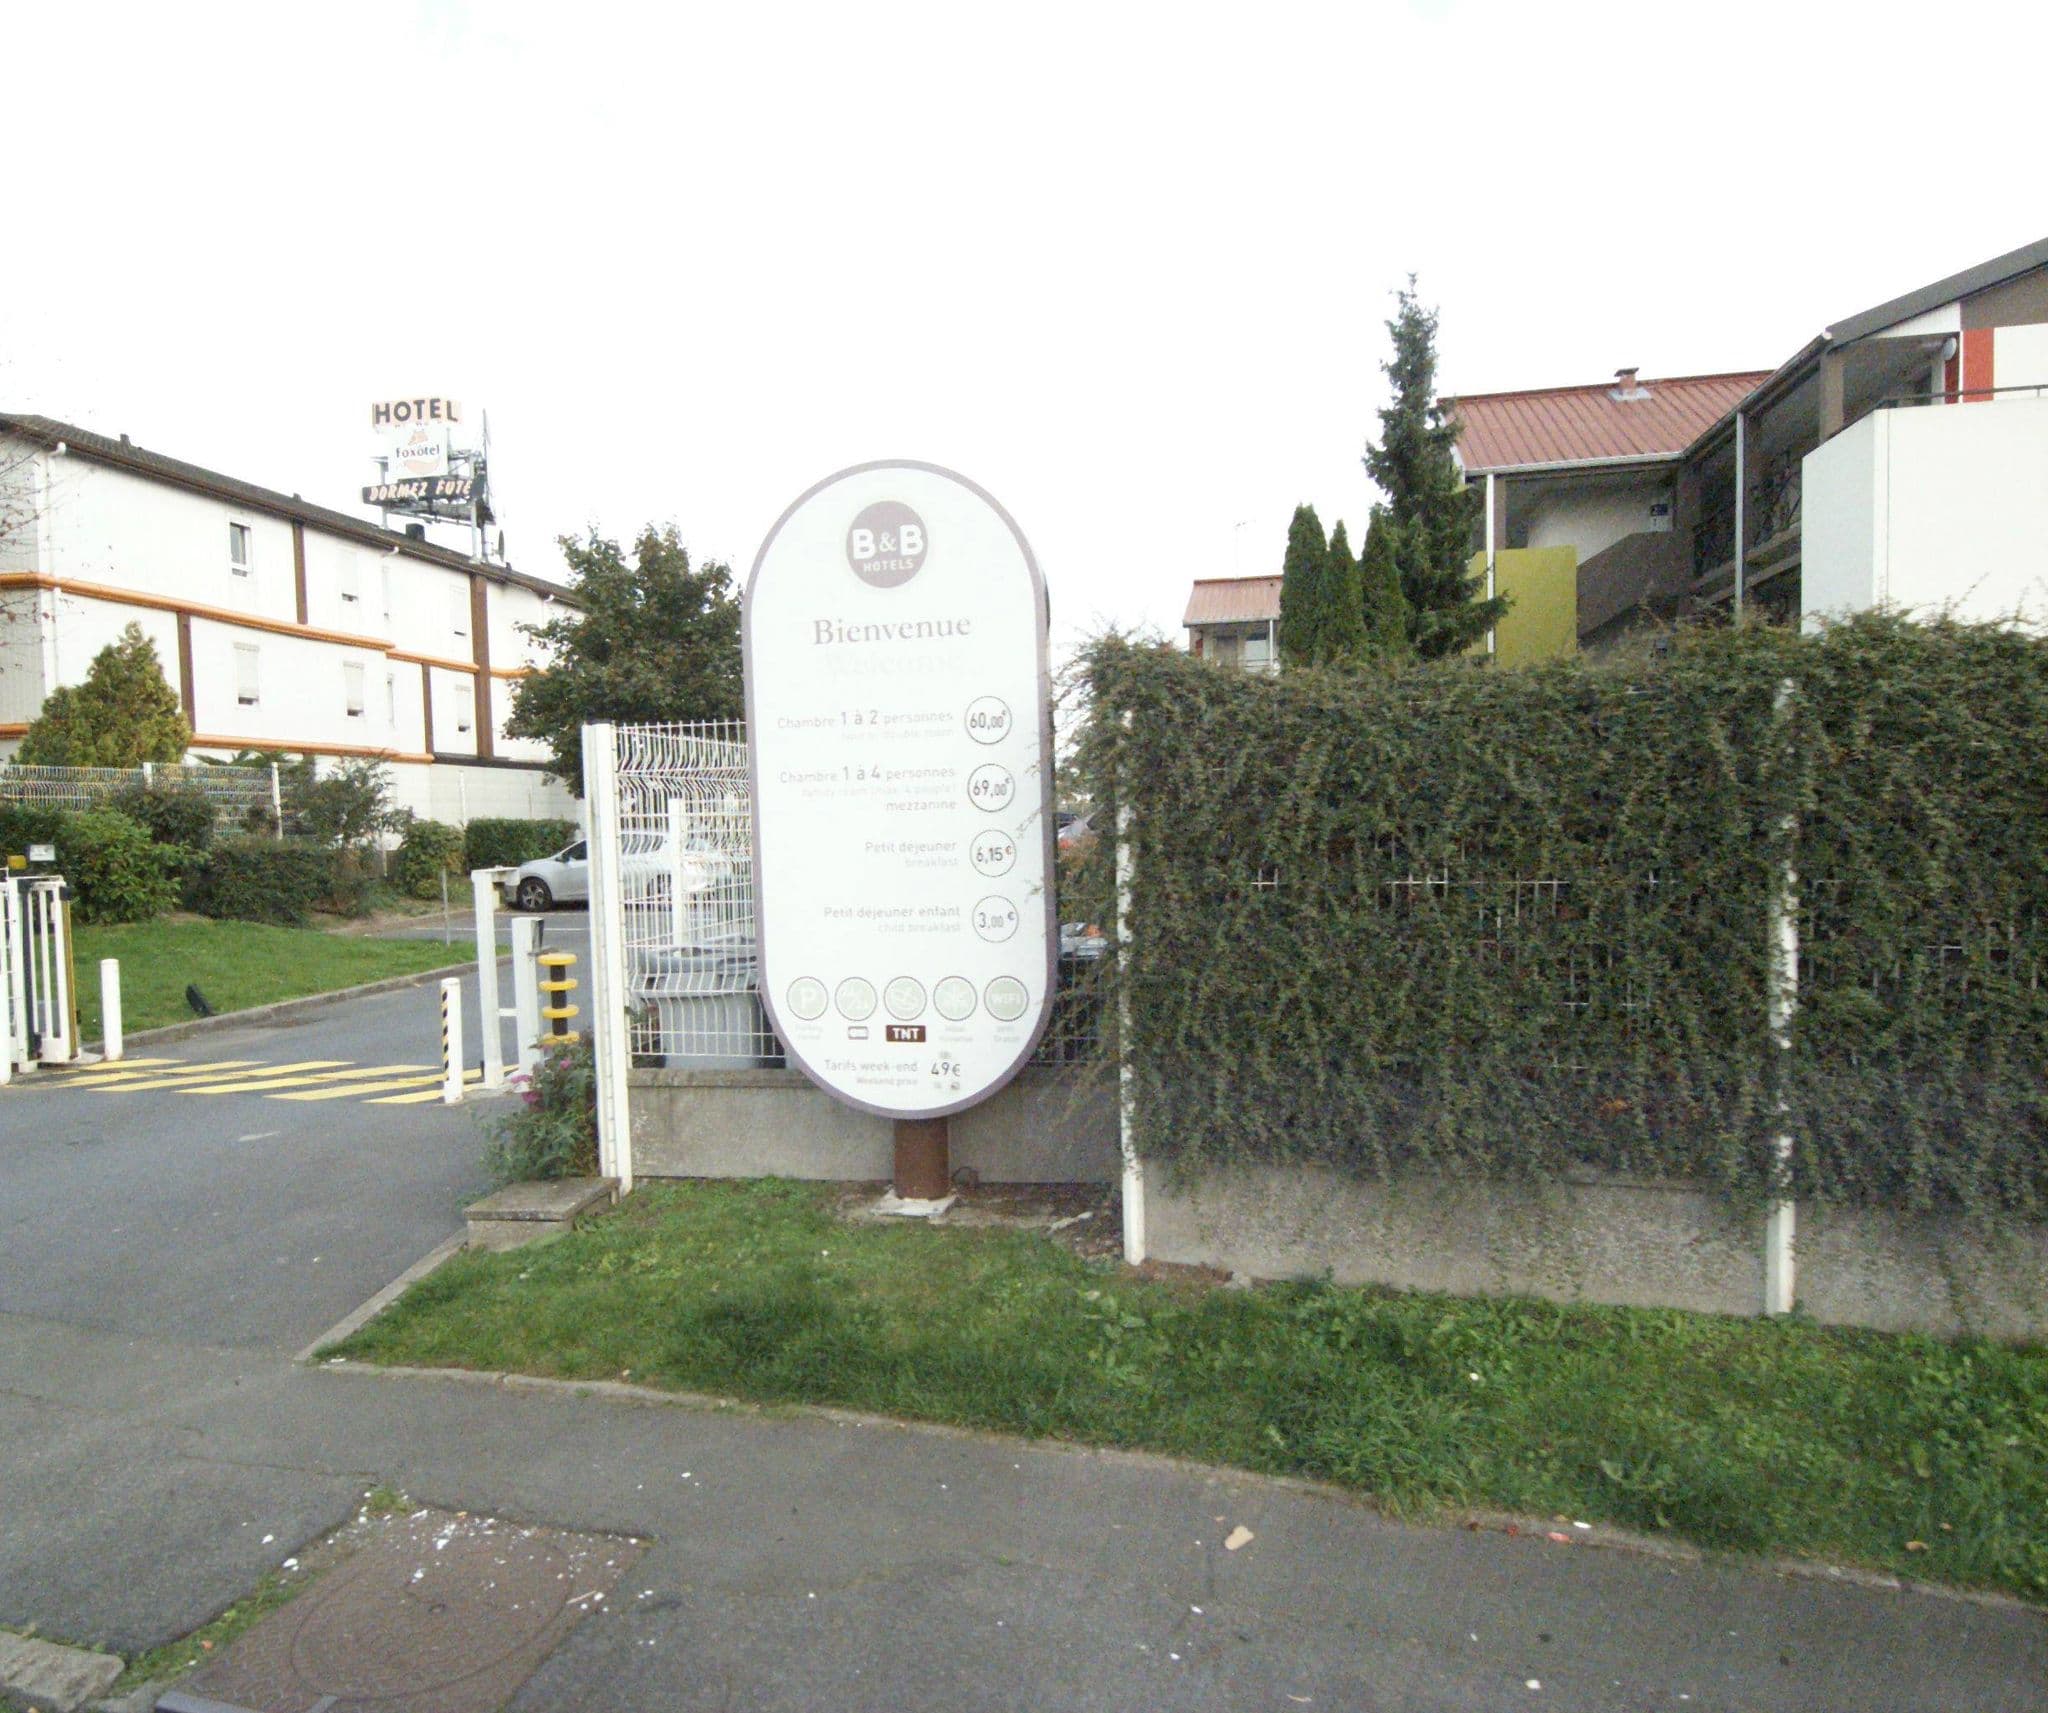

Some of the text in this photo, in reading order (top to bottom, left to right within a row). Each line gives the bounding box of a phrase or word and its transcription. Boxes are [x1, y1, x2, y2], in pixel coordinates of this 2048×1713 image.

[375, 398, 458, 424] HOTEL
[369, 481, 428, 501] DORMEZ
[852, 524, 923, 560] B&B
[864, 559, 914, 572] HOTELS
[813, 617, 971, 645] Bienvenue
[778, 717, 835, 730] Chambre
[841, 711, 847, 726] 1
[869, 710, 879, 726] 2
[884, 711, 954, 727] personnes
[780, 771, 838, 785] Chambre
[843, 766, 849, 781] 1
[871, 765, 881, 780] 4
[886, 766, 956, 782] personnes
[886, 800, 958, 812] mezzanine
[865, 841, 895, 854] Petit
[824, 907, 854, 918] Petit
[918, 905, 961, 917] enfant
[892, 1028, 920, 1040] TNT
[824, 1059, 857, 1072] Tarifs
[931, 1061, 961, 1077] 49€
